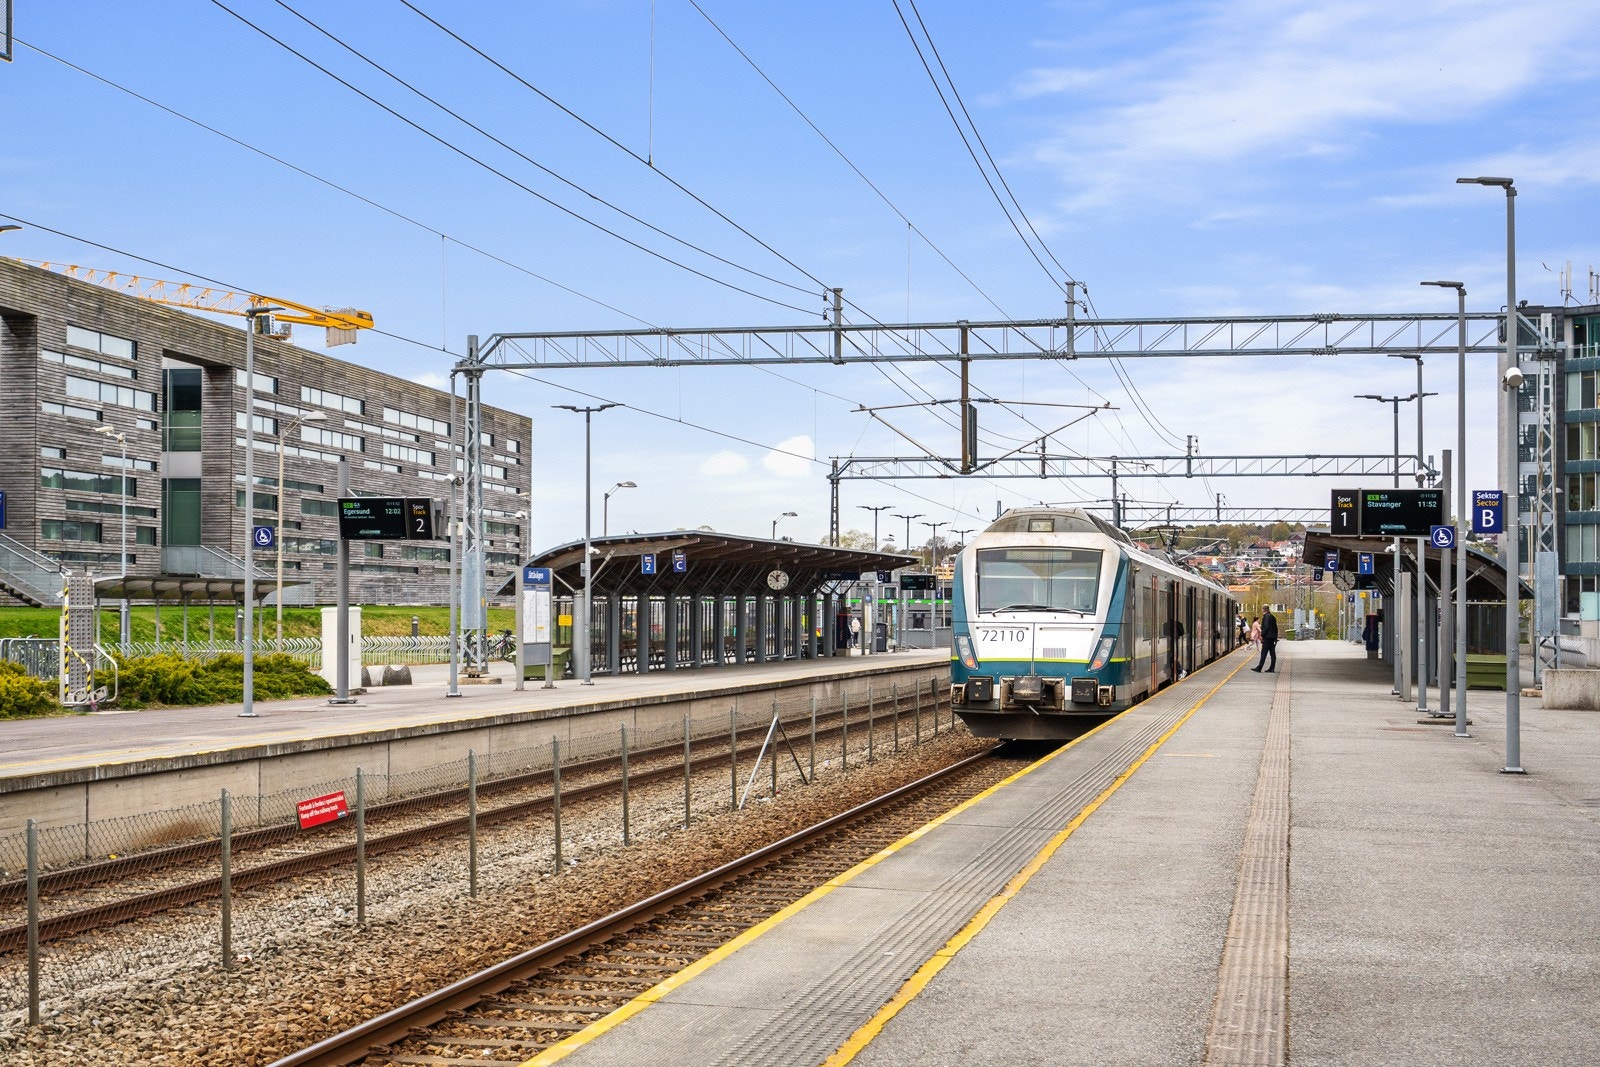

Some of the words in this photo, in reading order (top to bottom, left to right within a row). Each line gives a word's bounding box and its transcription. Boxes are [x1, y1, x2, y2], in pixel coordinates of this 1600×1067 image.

[416, 518, 424, 532] 2
[1340, 512, 1347, 527] 1
[1482, 509, 1494, 528] B
[676, 562, 682, 570] C
[1328, 560, 1335, 569] C
[982, 630, 1025, 642] 72110
